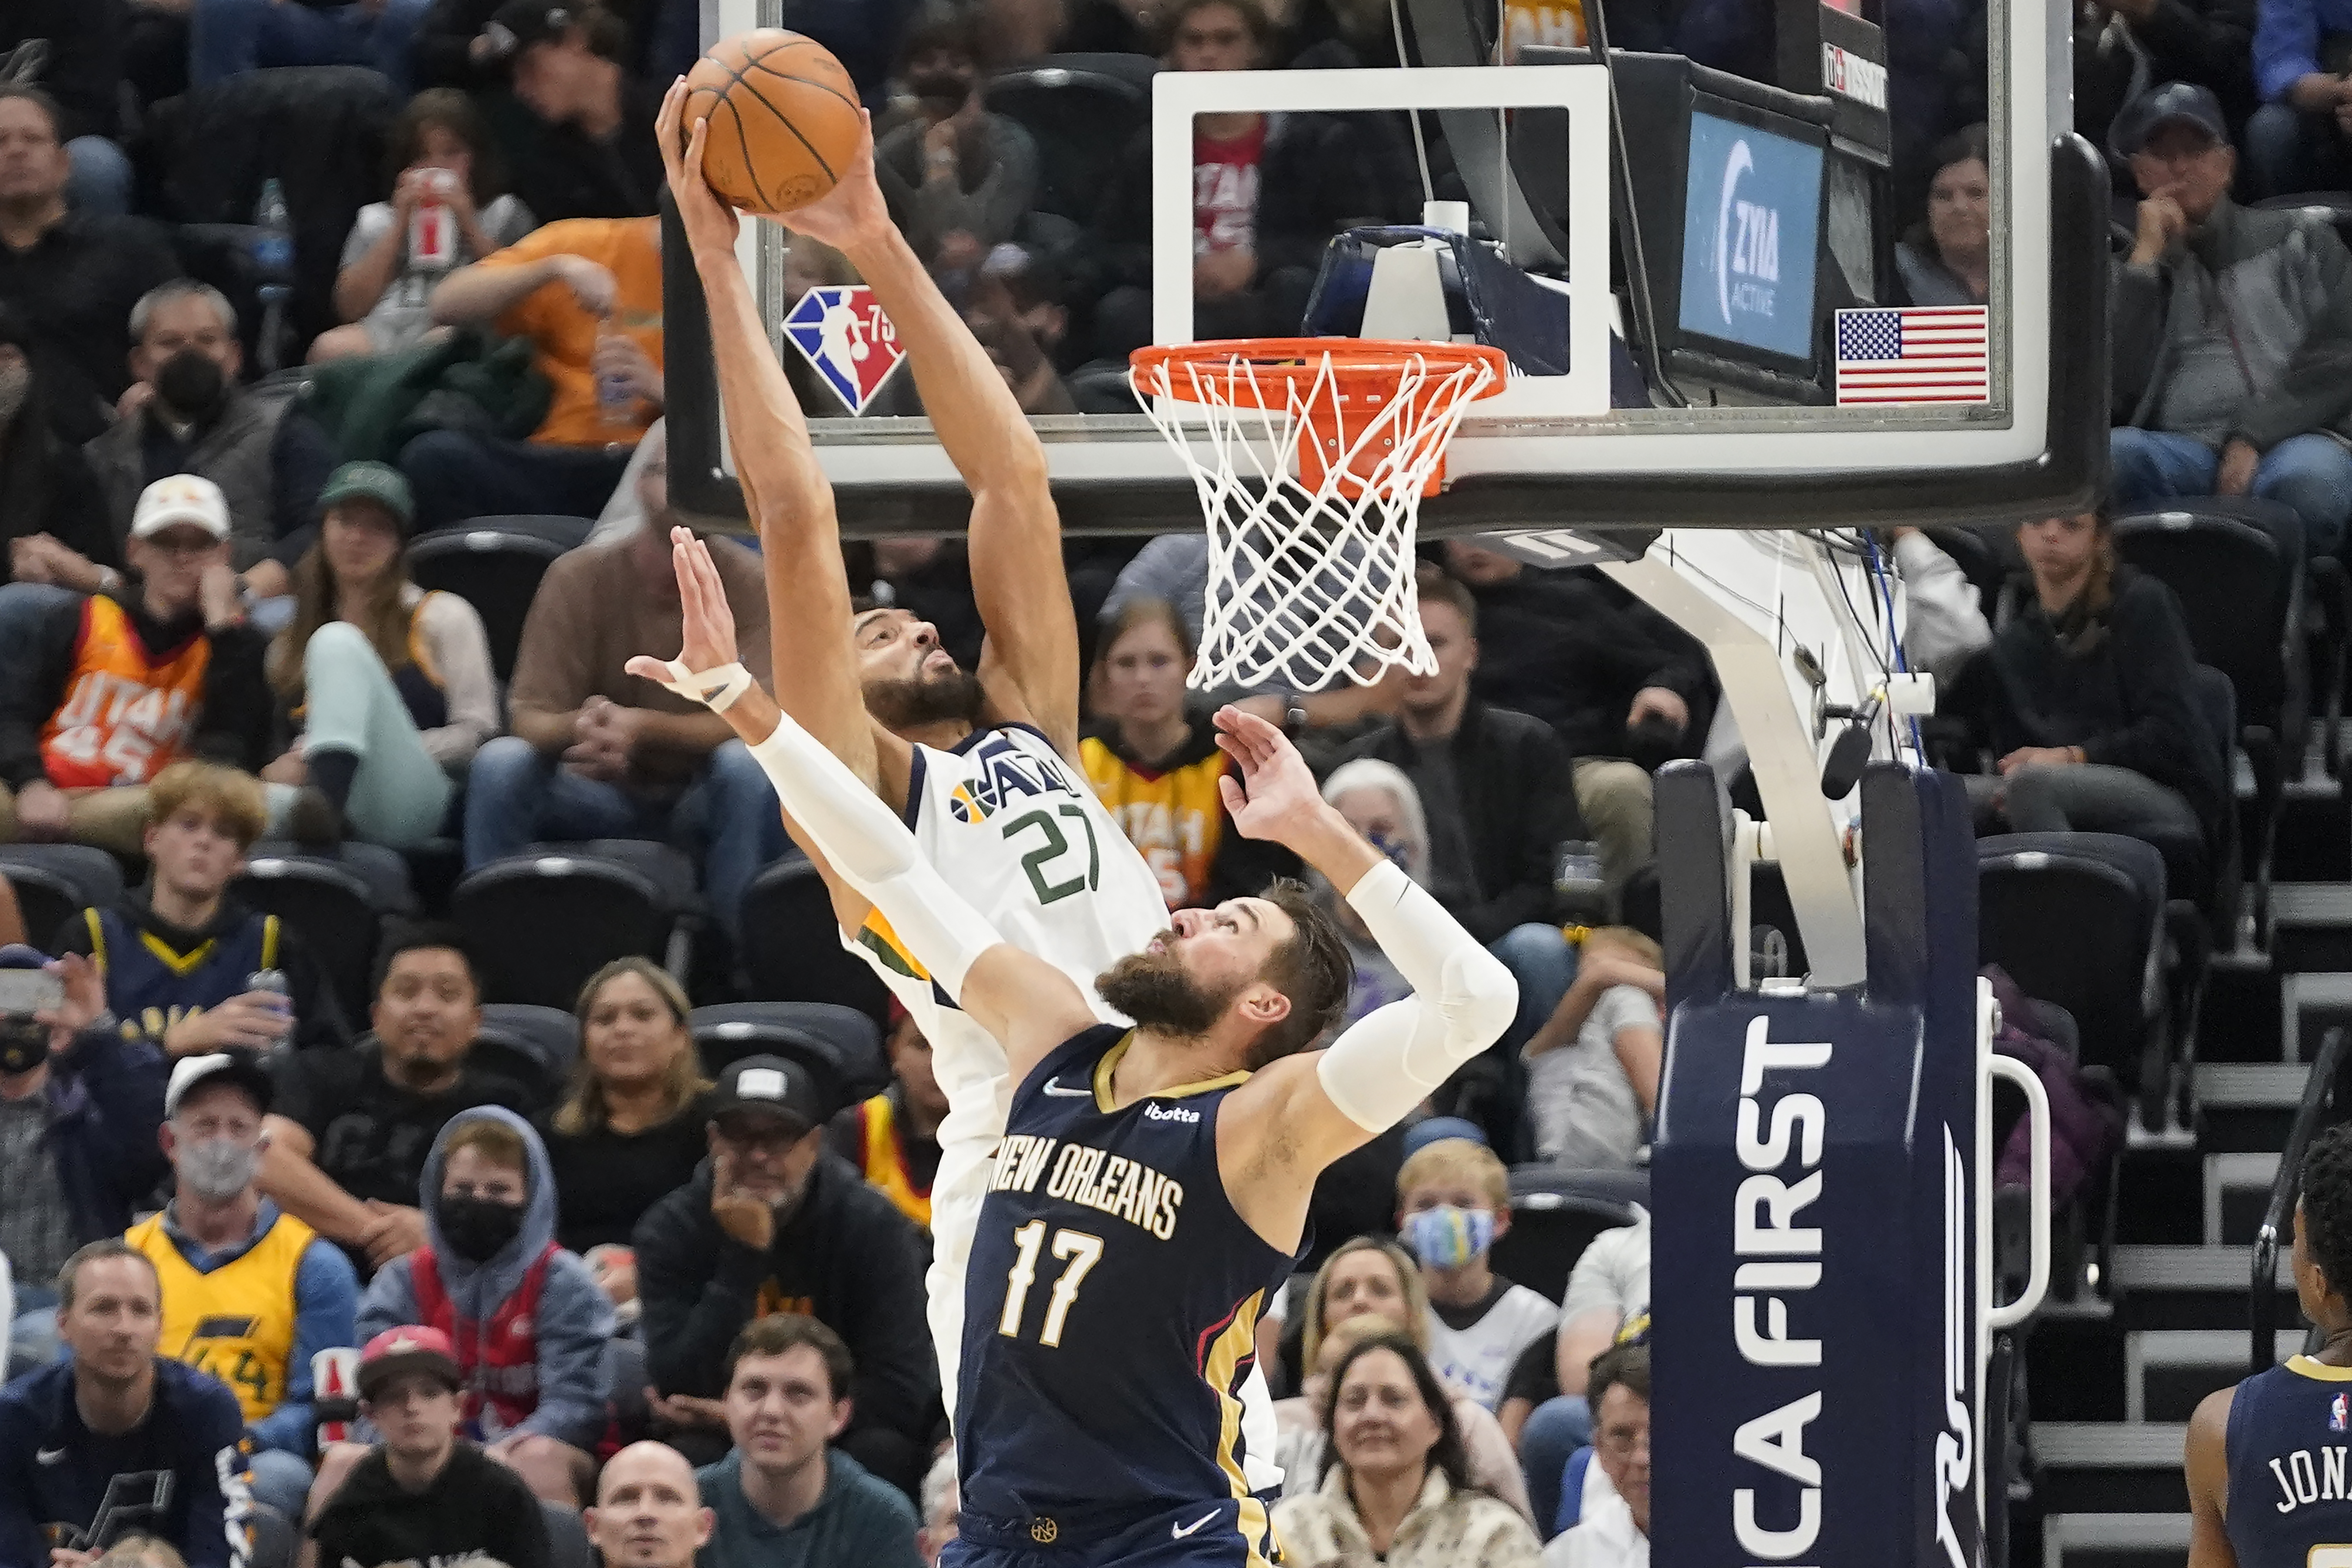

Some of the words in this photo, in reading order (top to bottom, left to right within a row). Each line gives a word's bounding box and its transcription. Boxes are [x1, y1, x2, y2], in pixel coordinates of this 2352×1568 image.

[867, 304, 896, 342] 75
[1002, 804, 1100, 906] 27
[1144, 1101, 1201, 1123] ibotta
[986, 1133, 1058, 1194] NEW
[1045, 1142, 1184, 1241] ORLEANS
[1734, 1014, 1833, 1367] FIRST
[998, 1218, 1105, 1349] 17
[1734, 1390, 1823, 1568] CA
[2268, 1446, 2352, 1514] JON
